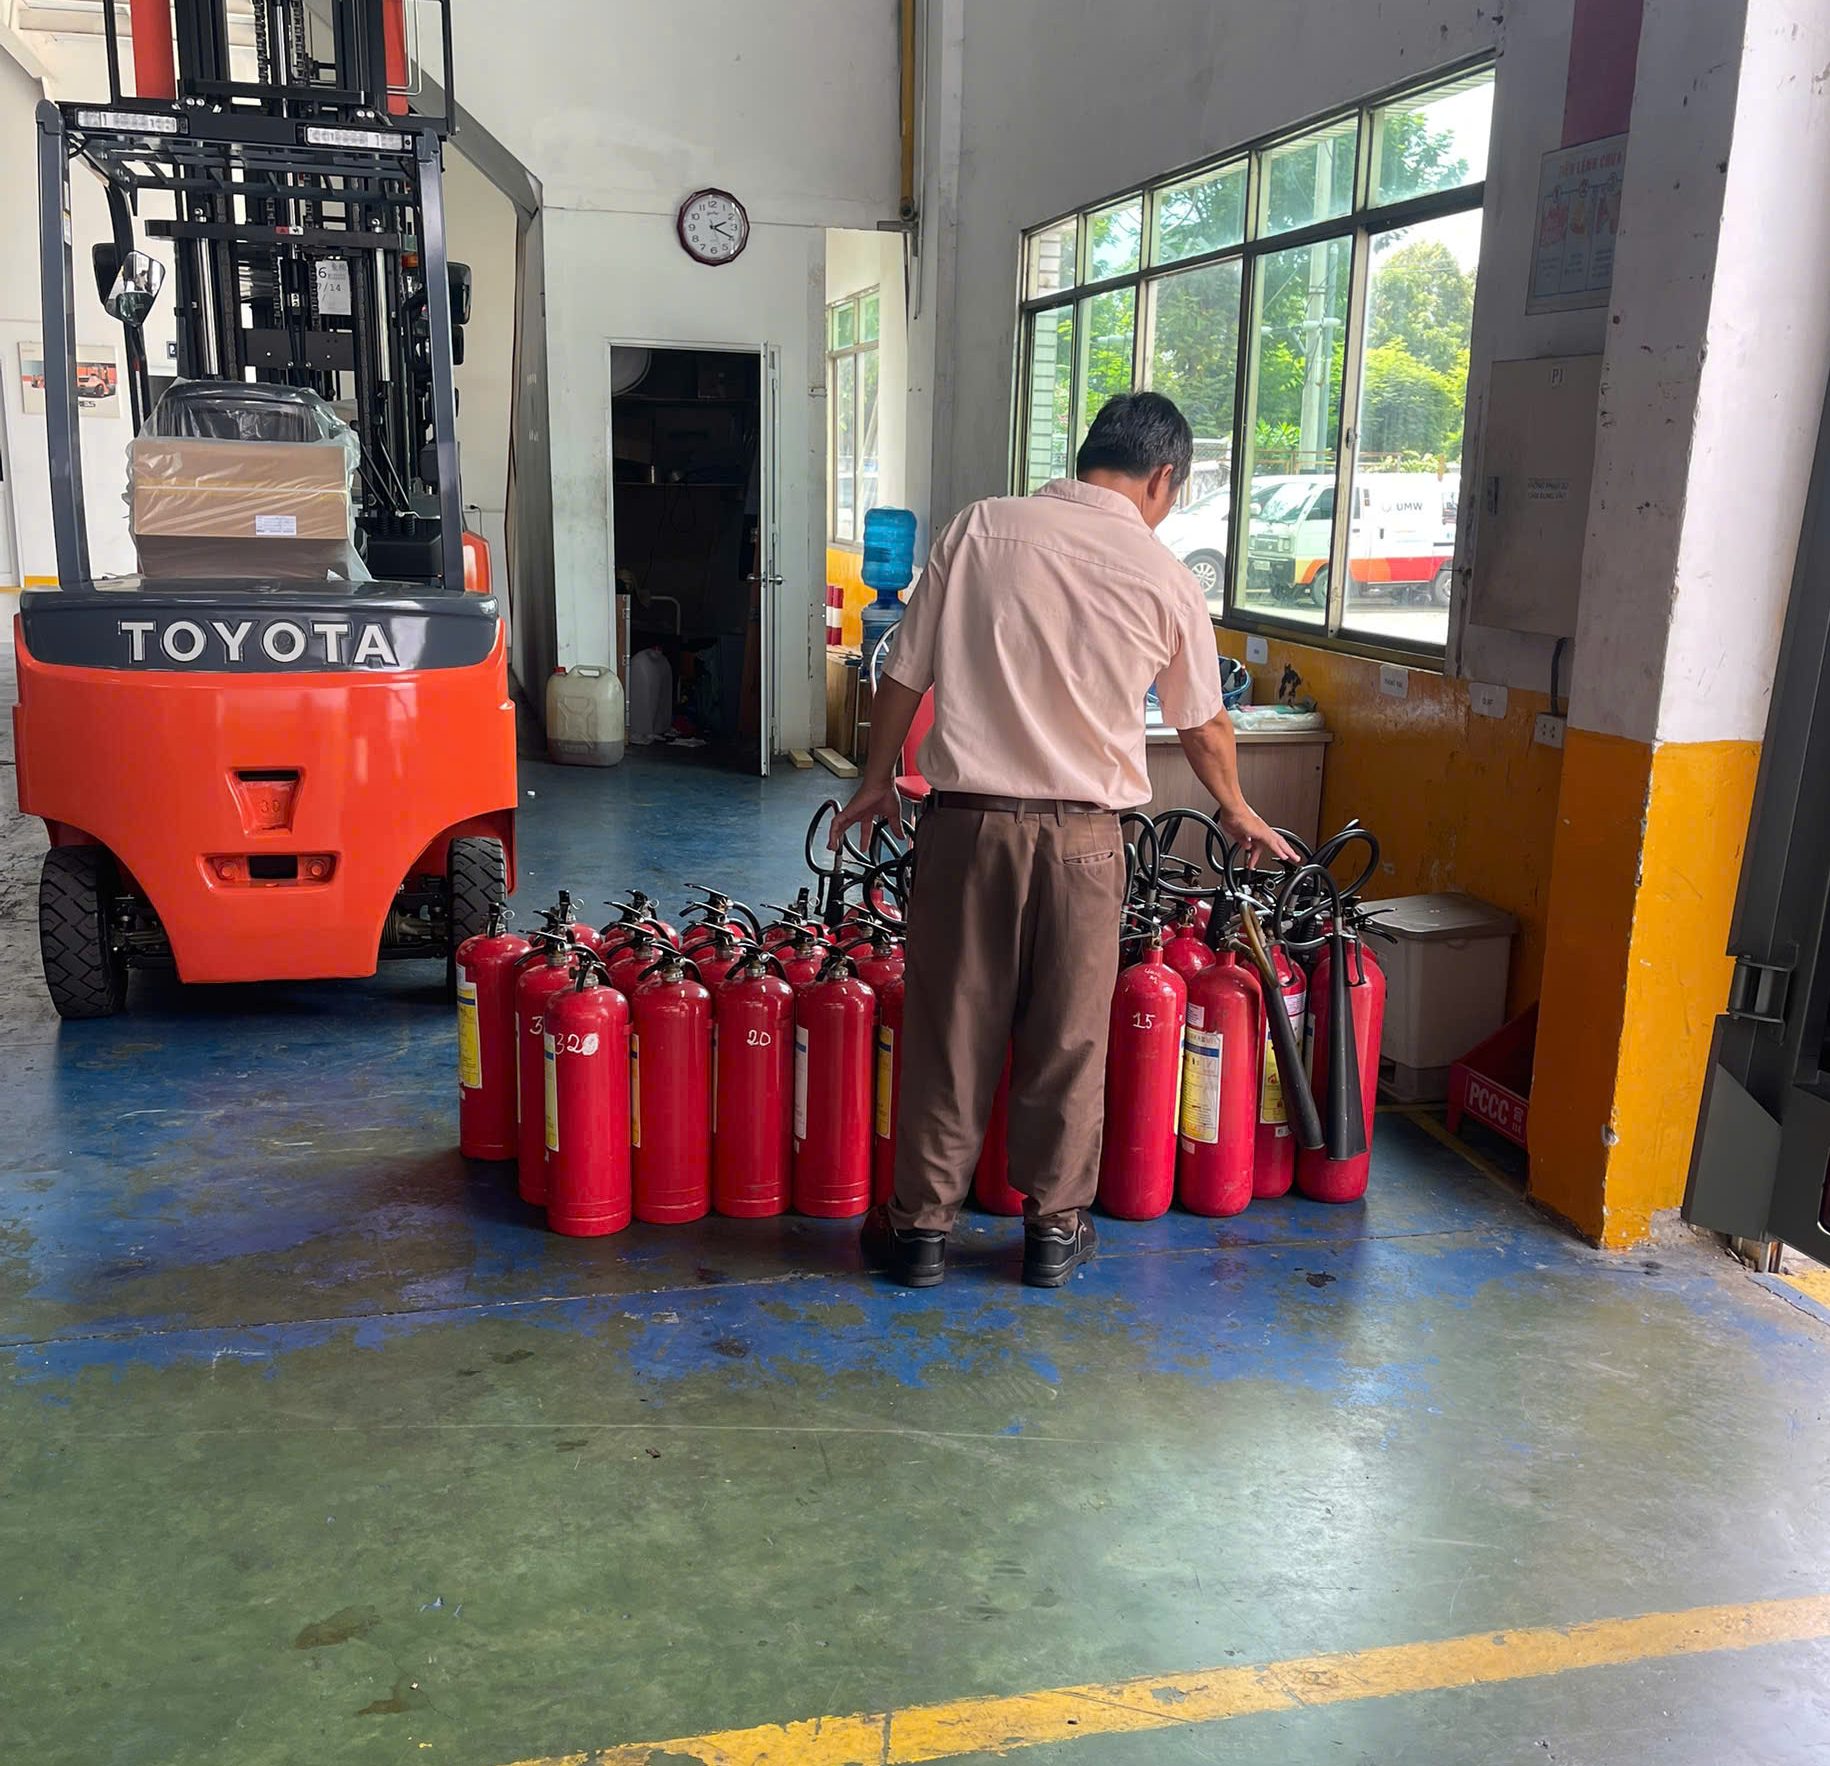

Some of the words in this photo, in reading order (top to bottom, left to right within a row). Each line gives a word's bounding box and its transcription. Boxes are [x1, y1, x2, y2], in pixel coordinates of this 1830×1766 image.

[708, 200, 717, 208] 12
[730, 223, 738, 231] 3
[700, 243, 706, 251] 7
[722, 243, 728, 251] 5
[1396, 502, 1423, 511] UMW
[118, 619, 399, 667] TOYOTA
[1132, 1012, 1156, 1029] 15
[746, 1029, 771, 1046] 20
[1468, 1081, 1510, 1125] PCCC
